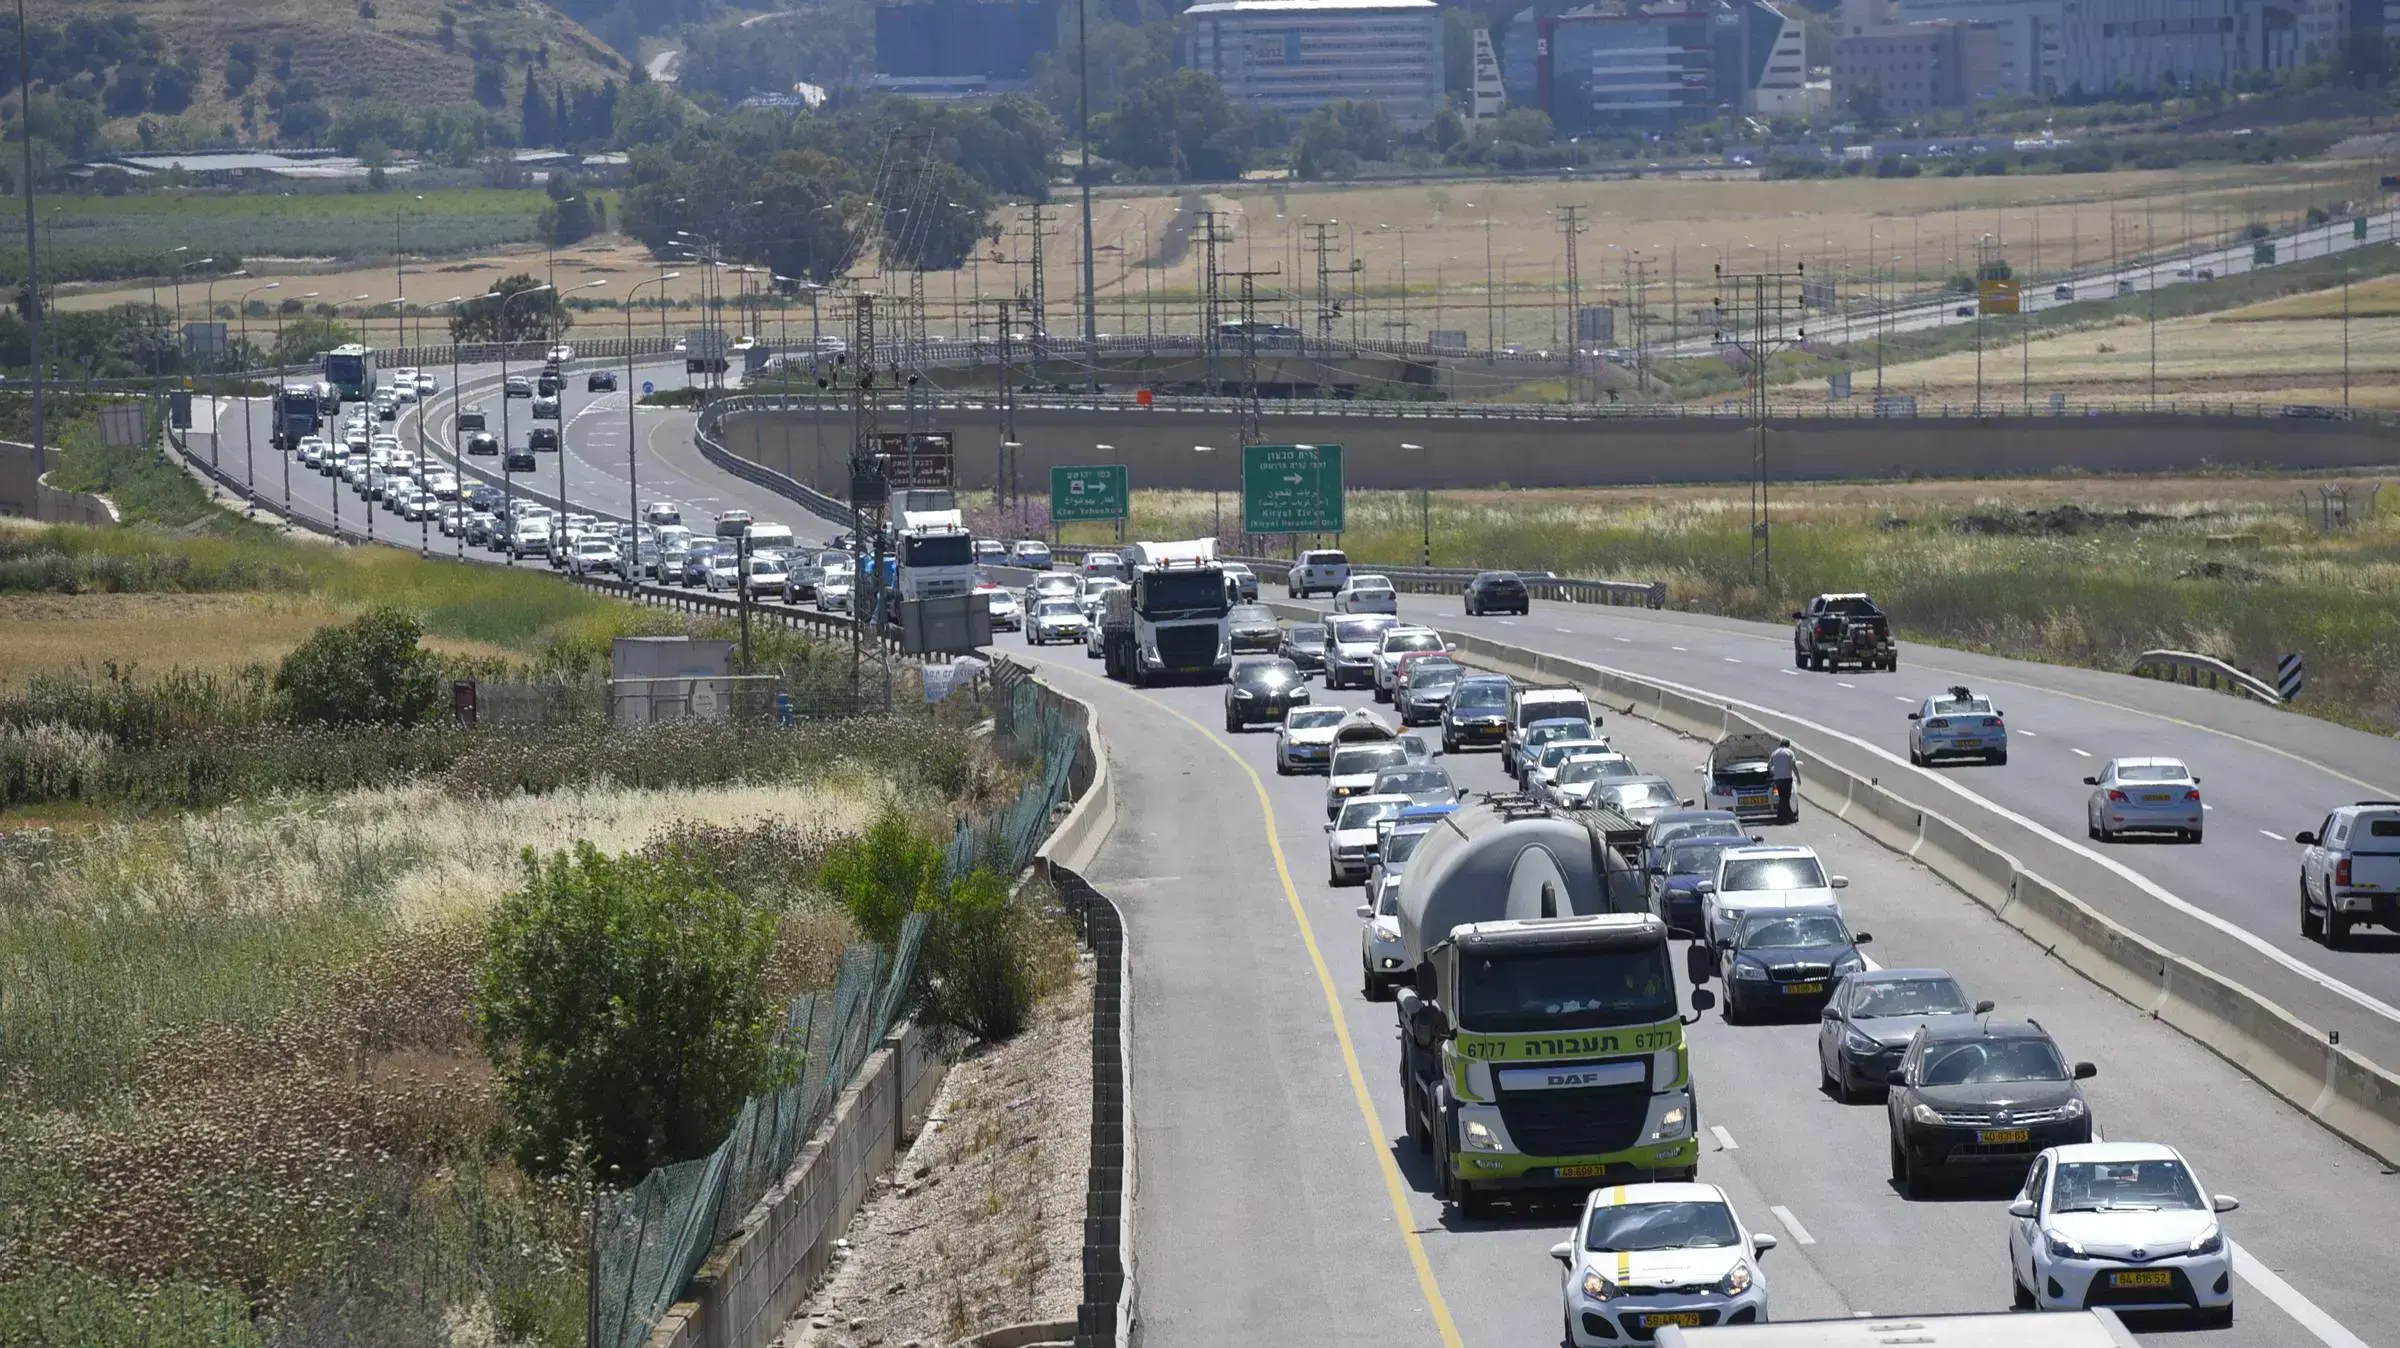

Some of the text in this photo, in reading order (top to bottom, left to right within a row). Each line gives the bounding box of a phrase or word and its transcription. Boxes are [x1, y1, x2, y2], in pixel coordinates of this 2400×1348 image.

[1468, 1031, 1673, 1058] 6777 תעבורה 6777
[1547, 1073, 1598, 1085] DAF
